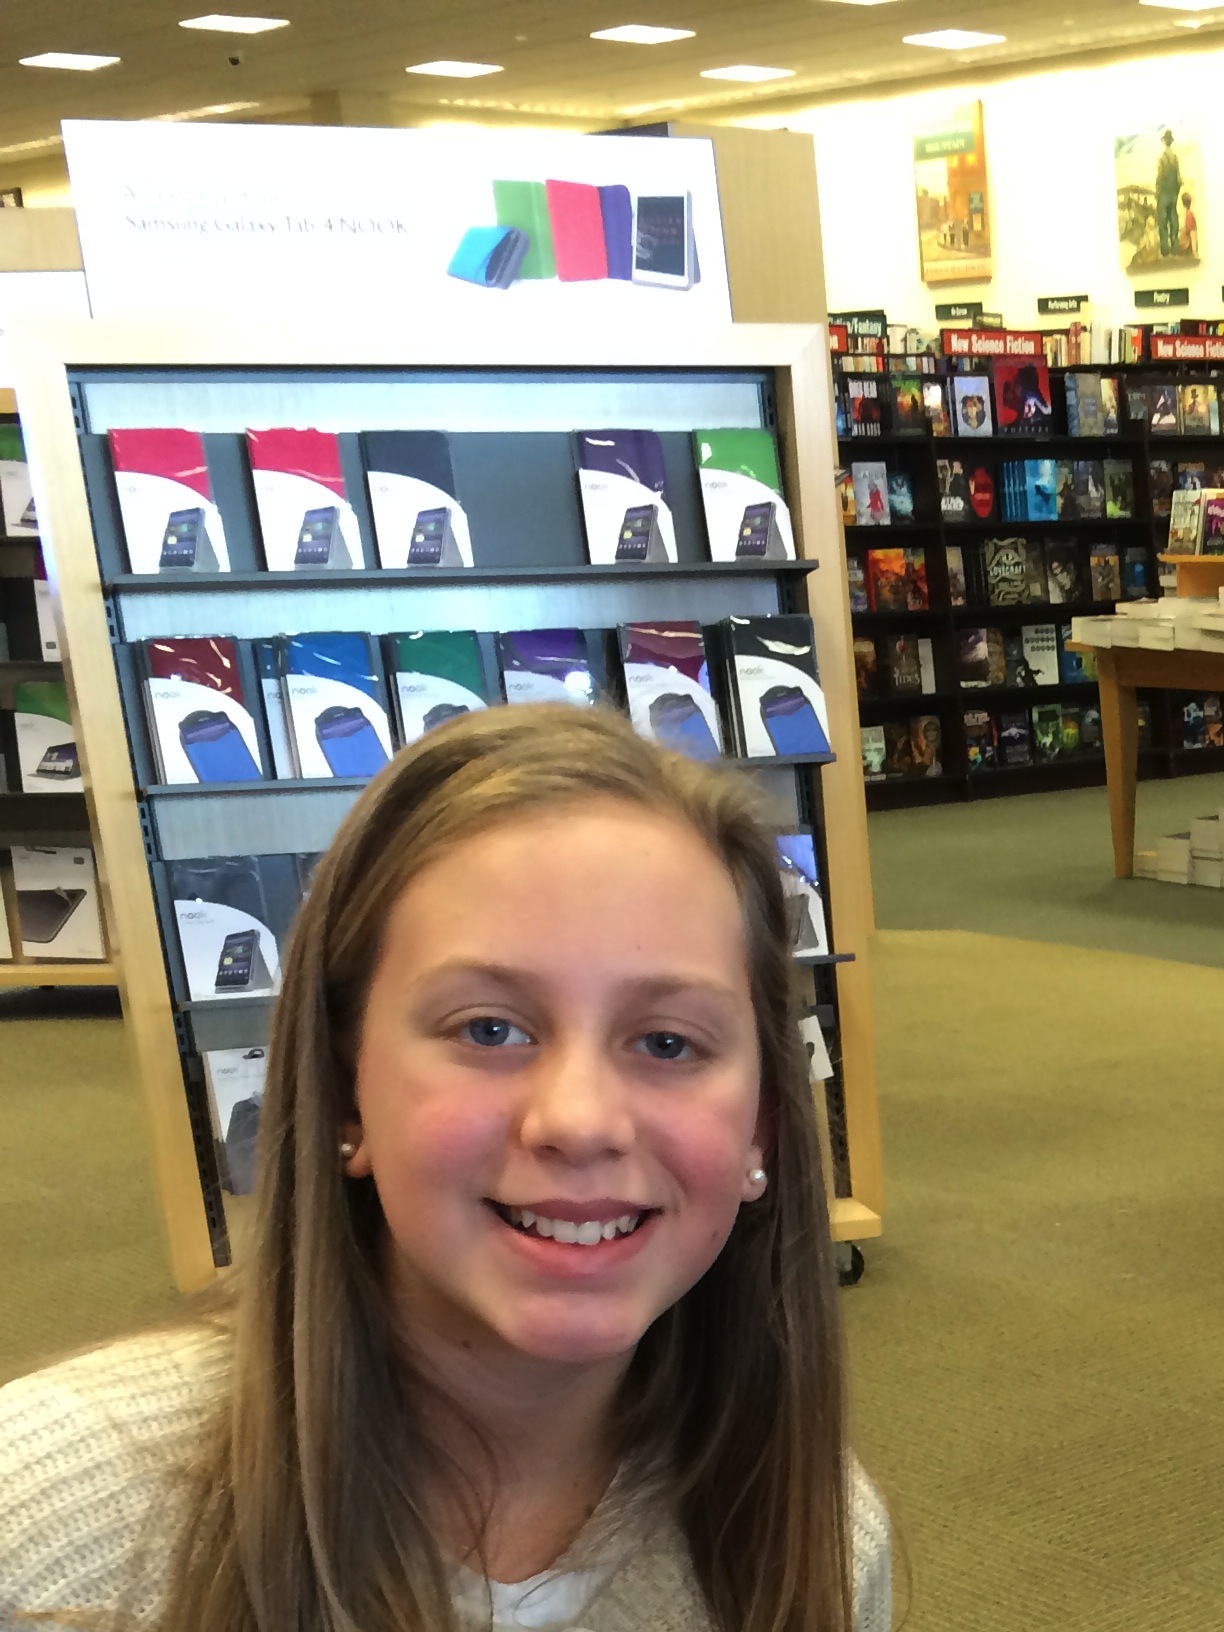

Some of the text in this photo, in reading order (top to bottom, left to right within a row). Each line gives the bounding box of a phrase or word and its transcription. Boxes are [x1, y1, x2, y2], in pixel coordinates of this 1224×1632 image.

[951, 333, 1035, 354] New Science Fiction
[1157, 339, 1173, 357] New
[1175, 339, 1204, 358] Science
